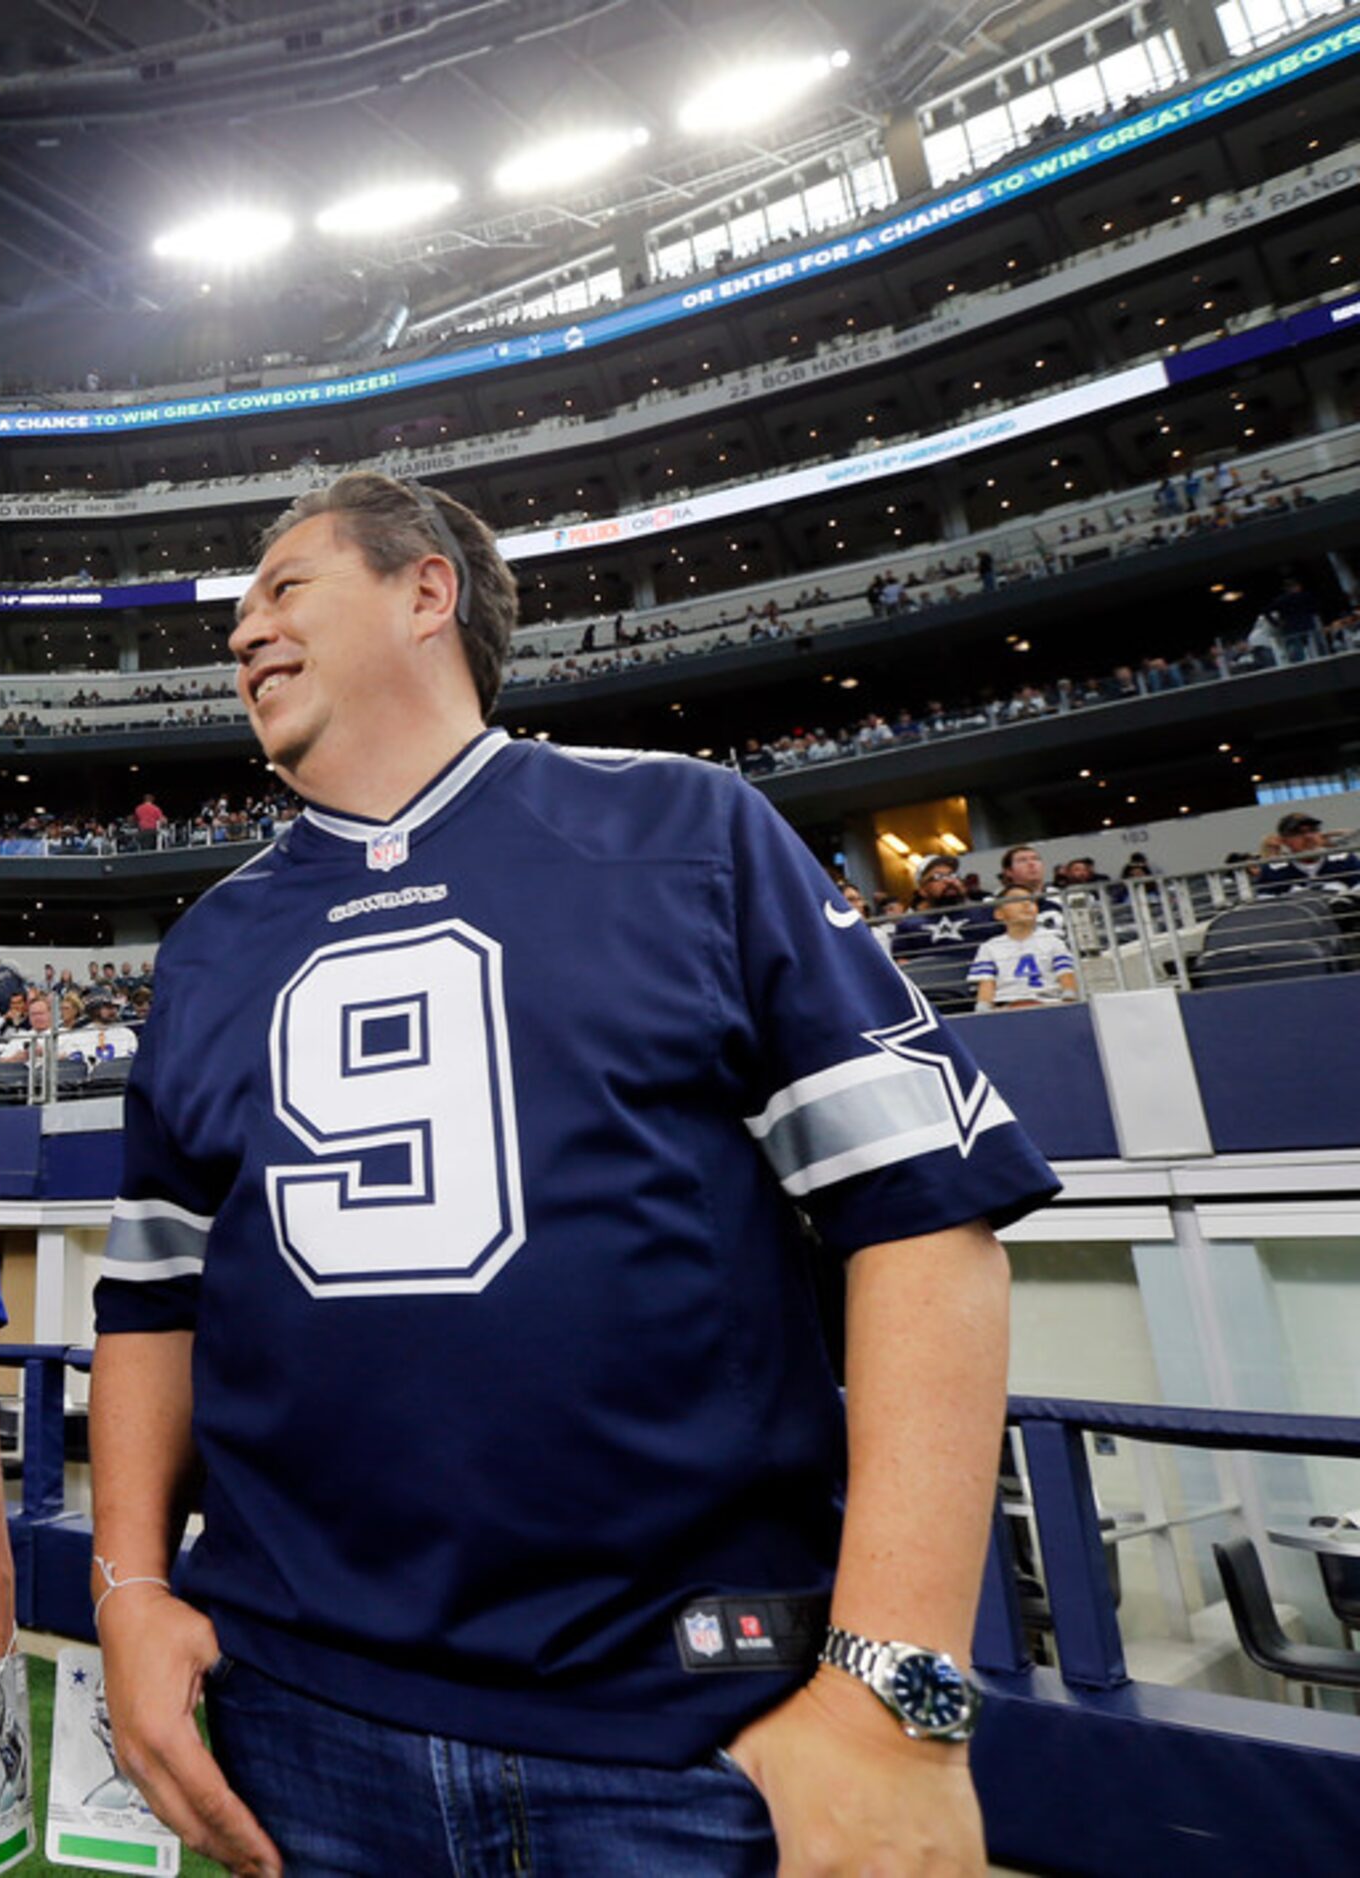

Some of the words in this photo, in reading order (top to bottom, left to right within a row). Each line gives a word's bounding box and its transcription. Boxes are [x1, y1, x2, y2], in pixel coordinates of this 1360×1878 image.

[682, 288, 713, 308] OR
[719, 262, 793, 299] ENTER
[800, 244, 849, 272] FOR
[855, 236, 874, 254] A
[878, 189, 984, 243] CHANCE
[989, 174, 1025, 198] TO
[1030, 145, 1089, 179] WIN
[1097, 101, 1194, 151] GREAT
[730, 383, 751, 399] 22
[761, 367, 805, 389] BOB
[812, 345, 881, 375] HAYES
[15, 415, 89, 430] CHANCE
[94, 413, 118, 427] TO
[122, 409, 158, 425] WIN
[164, 399, 222, 419] GREAT
[228, 387, 320, 411] COWBOYS
[326, 371, 397, 399] PRIZES!
[16, 503, 79, 518] WRIGHT
[1014, 953, 1044, 988] 4
[265, 917, 527, 1300] 9
